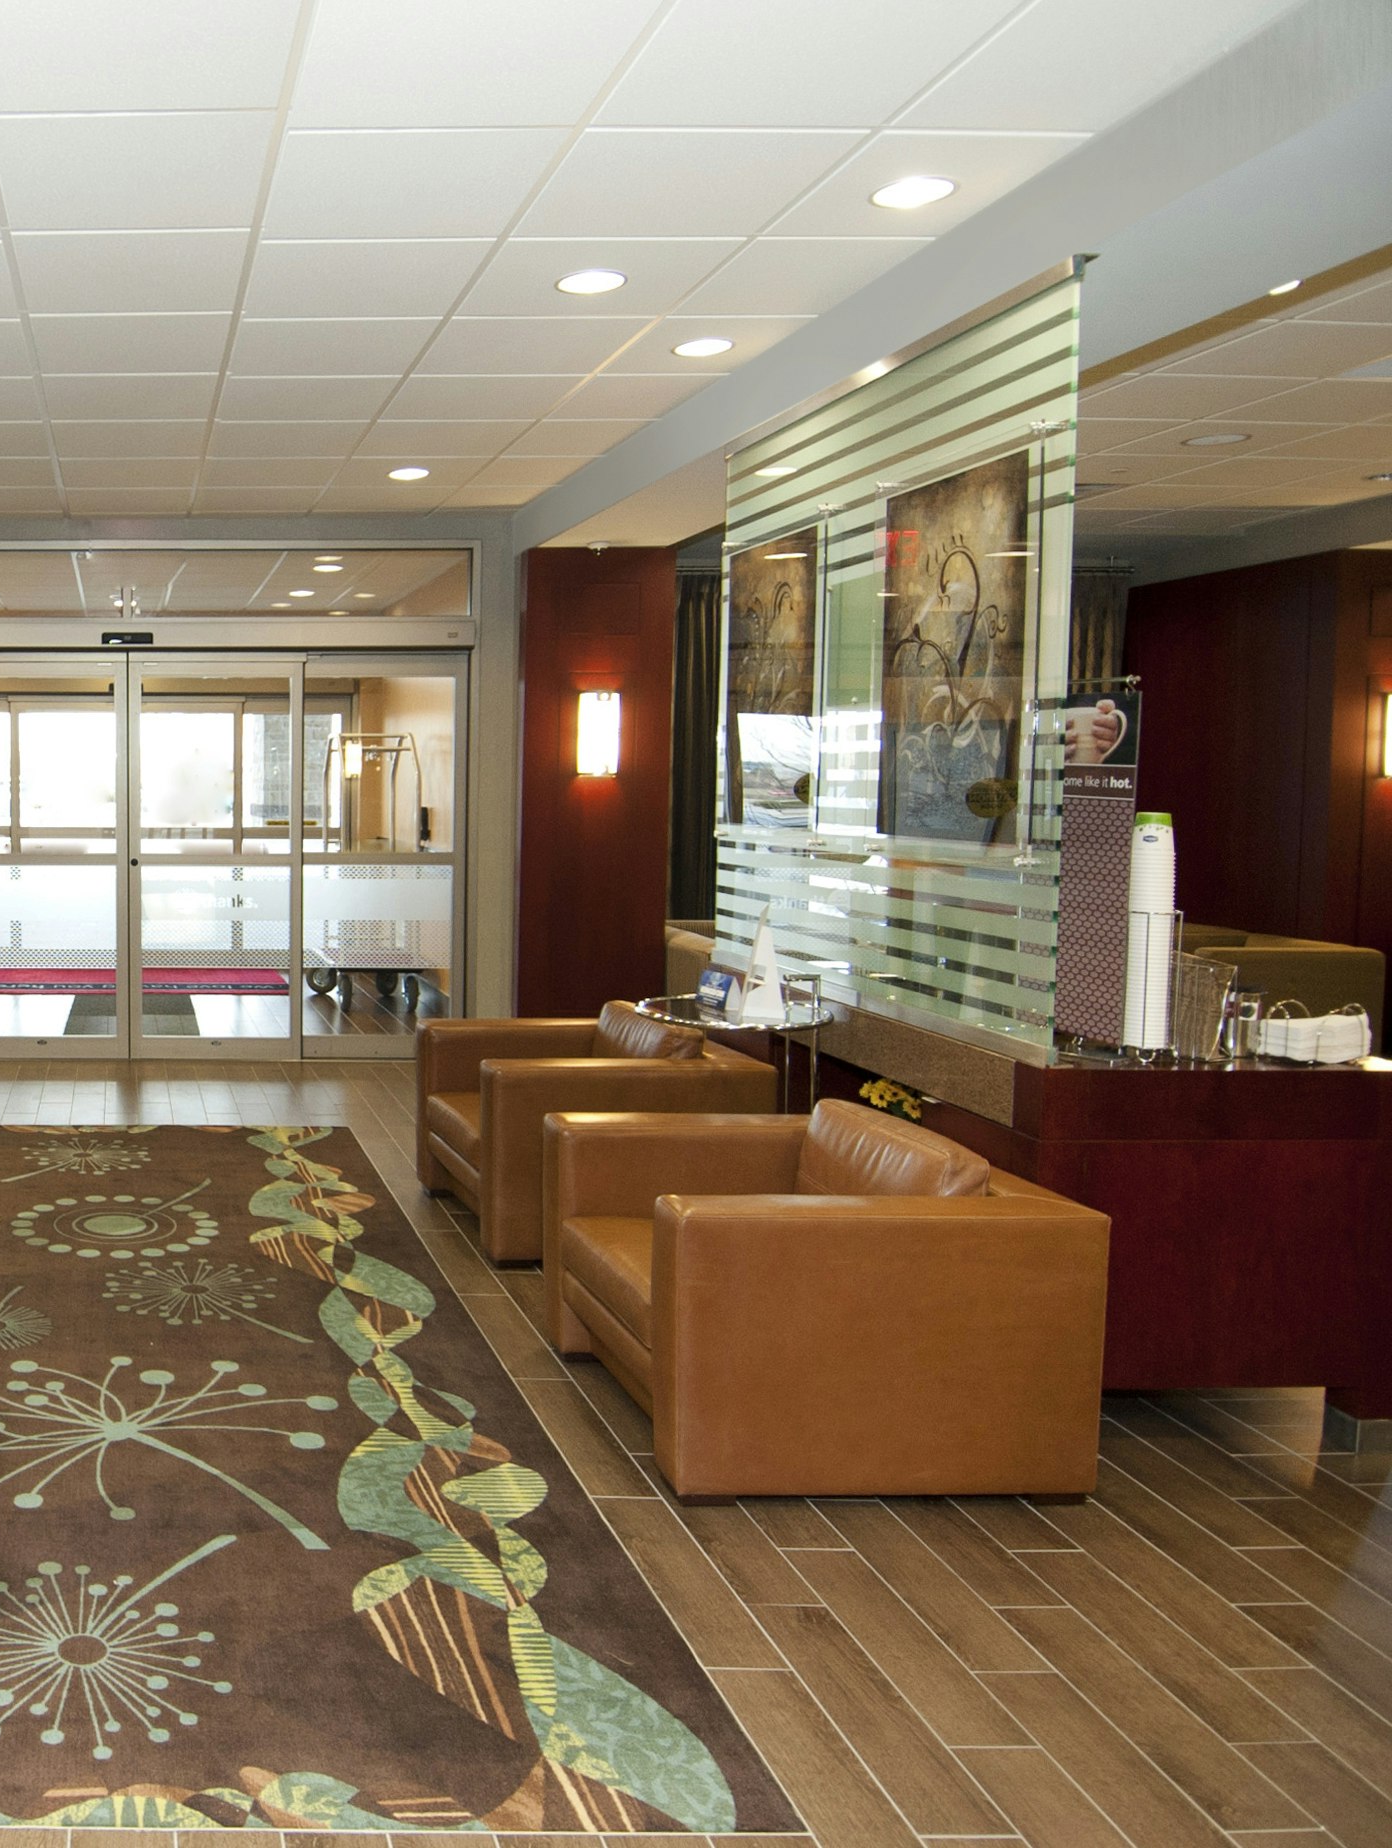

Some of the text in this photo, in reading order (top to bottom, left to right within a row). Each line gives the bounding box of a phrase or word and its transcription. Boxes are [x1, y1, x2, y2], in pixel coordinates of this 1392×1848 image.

[1063, 775, 1133, 789] ome like it hot.
[203, 892, 258, 908] hanks.
